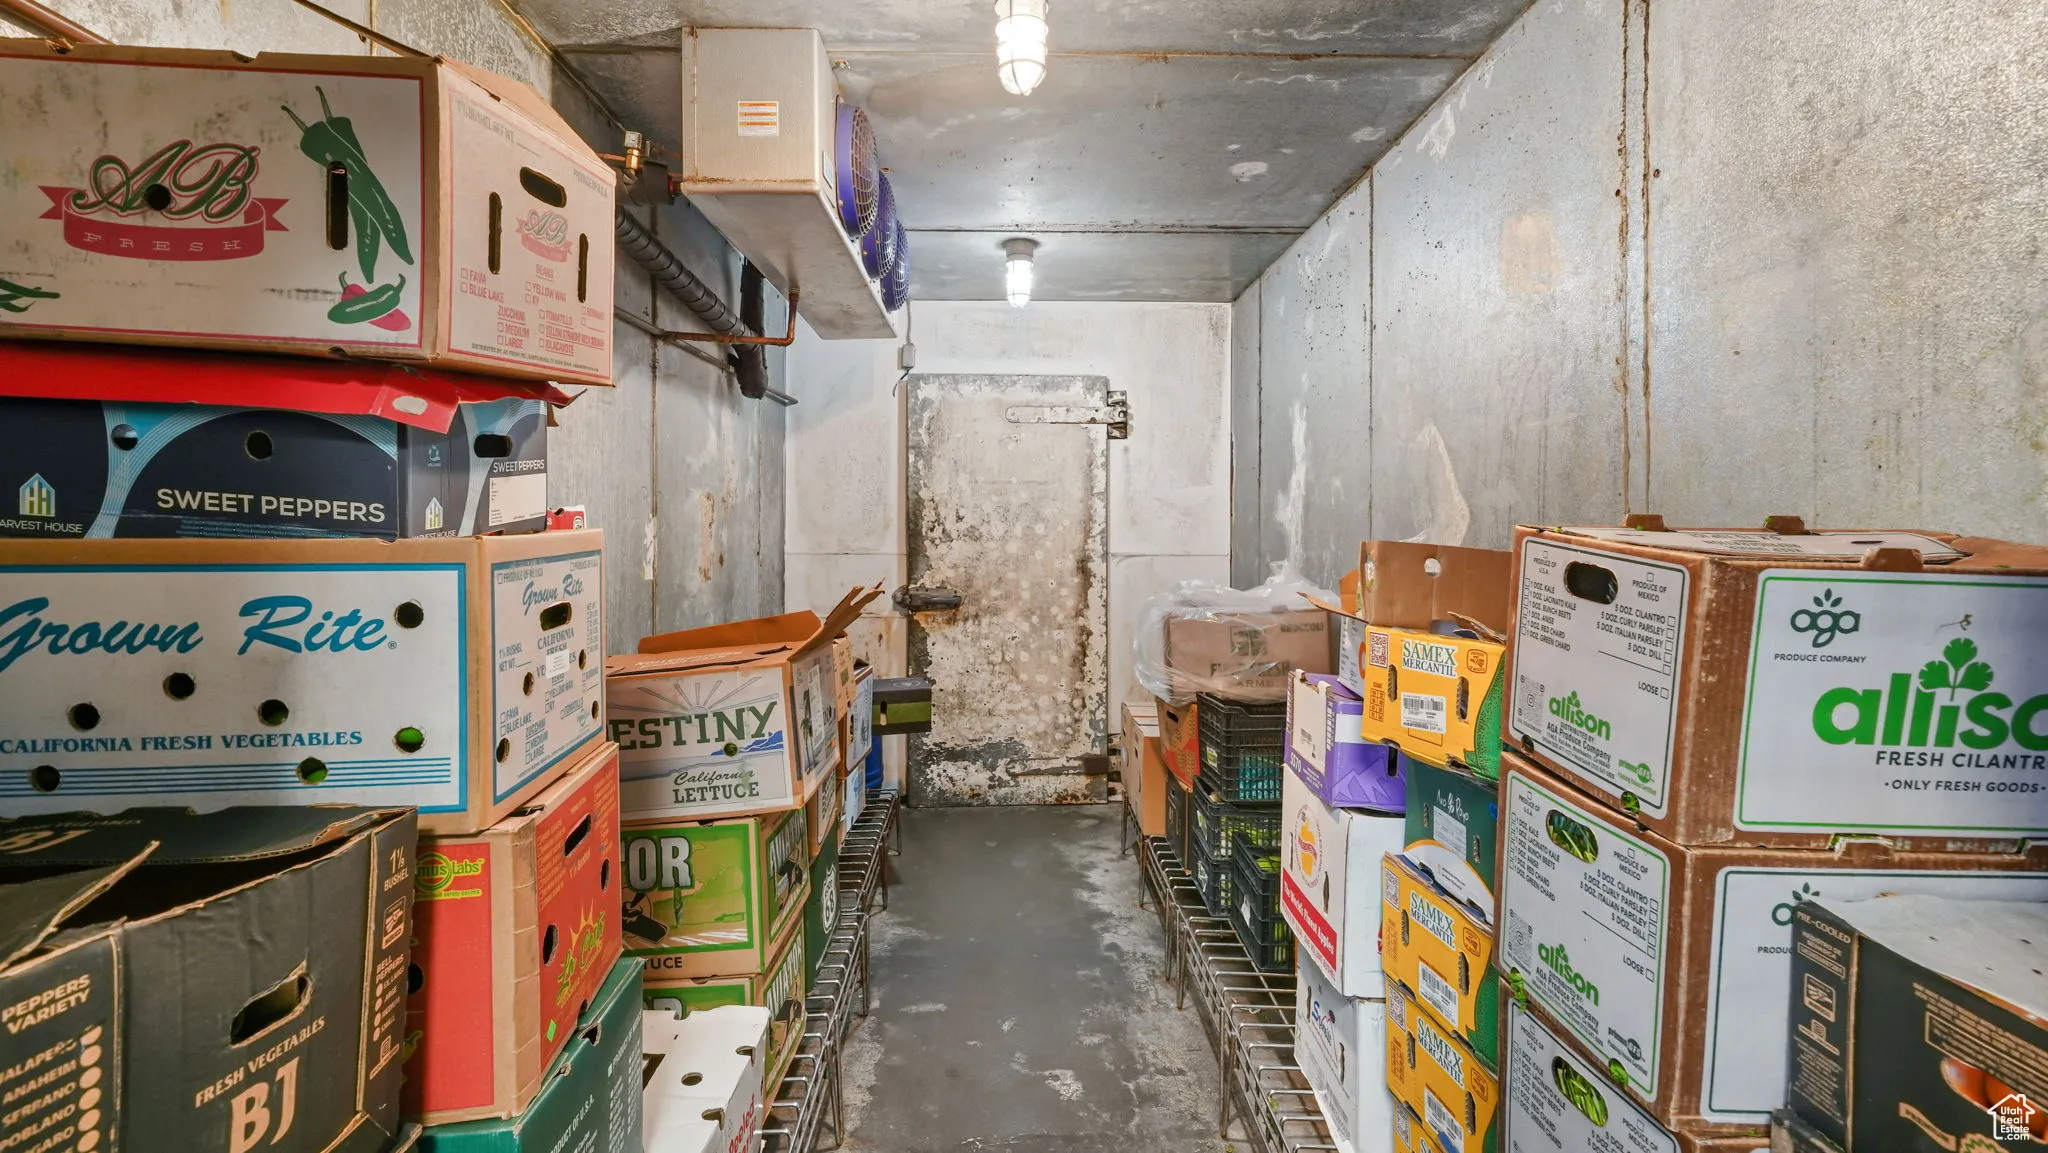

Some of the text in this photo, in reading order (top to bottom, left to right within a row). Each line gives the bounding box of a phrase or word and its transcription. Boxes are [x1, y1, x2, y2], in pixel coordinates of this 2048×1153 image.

[70, 139, 260, 224] AB
[84, 232, 241, 251] FRESH
[470, 270, 486, 284] FAVA
[469, 284, 504, 303] BLUE LAKE
[498, 305, 525, 321] ZUCCHINI
[505, 323, 529, 338] MEDIUM
[505, 337, 524, 349] LARGE
[493, 459, 544, 473] SWEET PEPPERS
[157, 489, 385, 522] SWEET PEPPERS
[0, 519, 82, 533] ARVEST HOUSE
[1534, 558, 1550, 567] PRODUCE
[522, 574, 583, 616] Grown Rite
[1544, 584, 1555, 594] KALE
[1633, 579, 1656, 591] PRODUCE
[1638, 590, 1660, 602] MEXICO
[1542, 604, 1571, 620] BUNCH BEETS
[1543, 594, 1576, 611] LACINATO KALE
[1605, 612, 1665, 636] DOZ. CURLY PARSLEY
[1619, 605, 1666, 624] DOZ. CILANTRO
[0, 596, 387, 672] Grown Rite
[538, 628, 574, 649] CALIFORNIA
[1540, 633, 1571, 651] GREEN CHARD
[1541, 624, 1565, 639] RED CHARD
[1601, 623, 1664, 648] DOZ. ITALIAN PARSLEY
[1404, 641, 1456, 666] SAMEX
[1633, 644, 1662, 661] DOZ. DILL
[1774, 653, 1867, 664] PRODUCE COMPANY
[1403, 658, 1456, 677] MERCANTIL
[1638, 681, 1659, 696] LOOSE
[1549, 696, 1611, 741] allison
[1812, 672, 2048, 751] alliso
[506, 712, 532, 734] BLUE LAKE
[607, 701, 777, 750] ESTINY
[0, 731, 363, 754] CALIFORNIA FRESH VEGETABLES
[1547, 722, 1558, 734] AGA
[1559, 728, 1581, 747] Produce
[1583, 741, 1611, 762] Company
[1876, 751, 2048, 770] FRESH CILANTR
[673, 781, 759, 803] LETTUCE
[1935, 781, 1981, 792] FRESH
[1529, 825, 1539, 838] KALE
[417, 861, 479, 877] mus Labs
[1613, 851, 1648, 874] PRODUCE OF
[1619, 865, 1641, 881] MEXICO
[384, 868, 408, 891] BUSHEL
[1602, 882, 1648, 916] CURLY PARSLEY
[1617, 881, 1648, 905] CILANTRO
[1411, 892, 1455, 937] SAMEX
[1598, 891, 1647, 927] ITALIAN PARSLEY
[1411, 910, 1455, 949] MERCANTIL
[1633, 925, 1646, 941] DILL
[1797, 911, 1851, 943] PRE-COOLED
[376, 954, 404, 984] PEPPERS
[377, 955, 392, 974] BELL
[1538, 943, 1599, 1007] allison
[1623, 955, 1644, 975] LOOSE
[2, 974, 91, 1023] PEPPERS
[1536, 966, 1599, 1027] AGA Company
[7, 988, 91, 1034] VARIETY
[1418, 1018, 1462, 1075] SAMEX
[195, 1016, 325, 1108] FRESH VEGETABLES
[1418, 1034, 1463, 1086] MERCANTIL
[3, 1059, 77, 1106] ANAHEIM
[229, 1056, 300, 1153] BJ
[0, 1104, 76, 1152] POBLANO
[1622, 1118, 1650, 1143] PRODUCE
